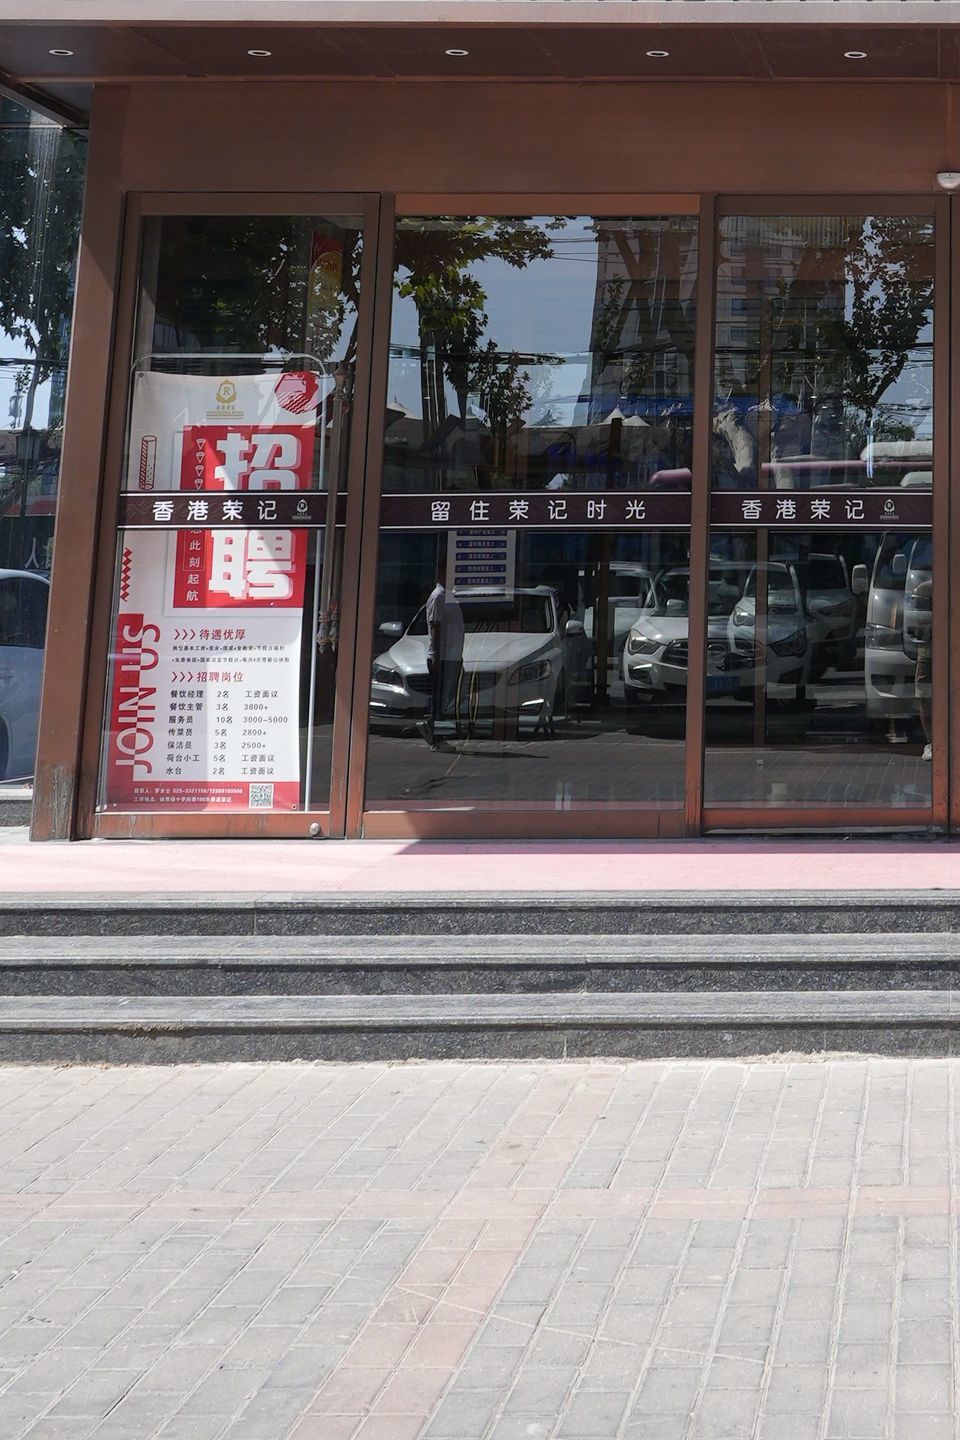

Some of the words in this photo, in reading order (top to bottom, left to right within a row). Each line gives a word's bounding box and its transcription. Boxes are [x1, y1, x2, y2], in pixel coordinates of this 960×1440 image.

[152, 500, 277, 521] 香港荣记
[431, 500, 646, 522] 留住荣记时光
[741, 499, 865, 520] 香港荣记
[186, 530, 202, 602] 此刻起航
[199, 629, 246, 640] 待遇优厚
[121, 624, 160, 670] US
[197, 671, 244, 682] 招聘岗位
[170, 690, 204, 698] 餐饮经理
[217, 690, 229, 698] 2名
[246, 690, 278, 698] 工资面议
[169, 702, 203, 711] 餐饮主管
[216, 703, 228, 711] 3名
[244, 703, 268, 711] 3800+
[168, 715, 193, 724] 服务员
[216, 716, 233, 724] 10名
[115, 687, 157, 774] JOIN
[168, 728, 193, 736] 传菜员
[167, 741, 192, 749] 保洁员
[214, 741, 226, 749] 3名
[213, 754, 226, 762] 5名
[242, 754, 275, 762] 工资面议
[165, 767, 182, 775] 水台
[212, 767, 225, 775] 2名
[240, 767, 274, 775] 工资面议
